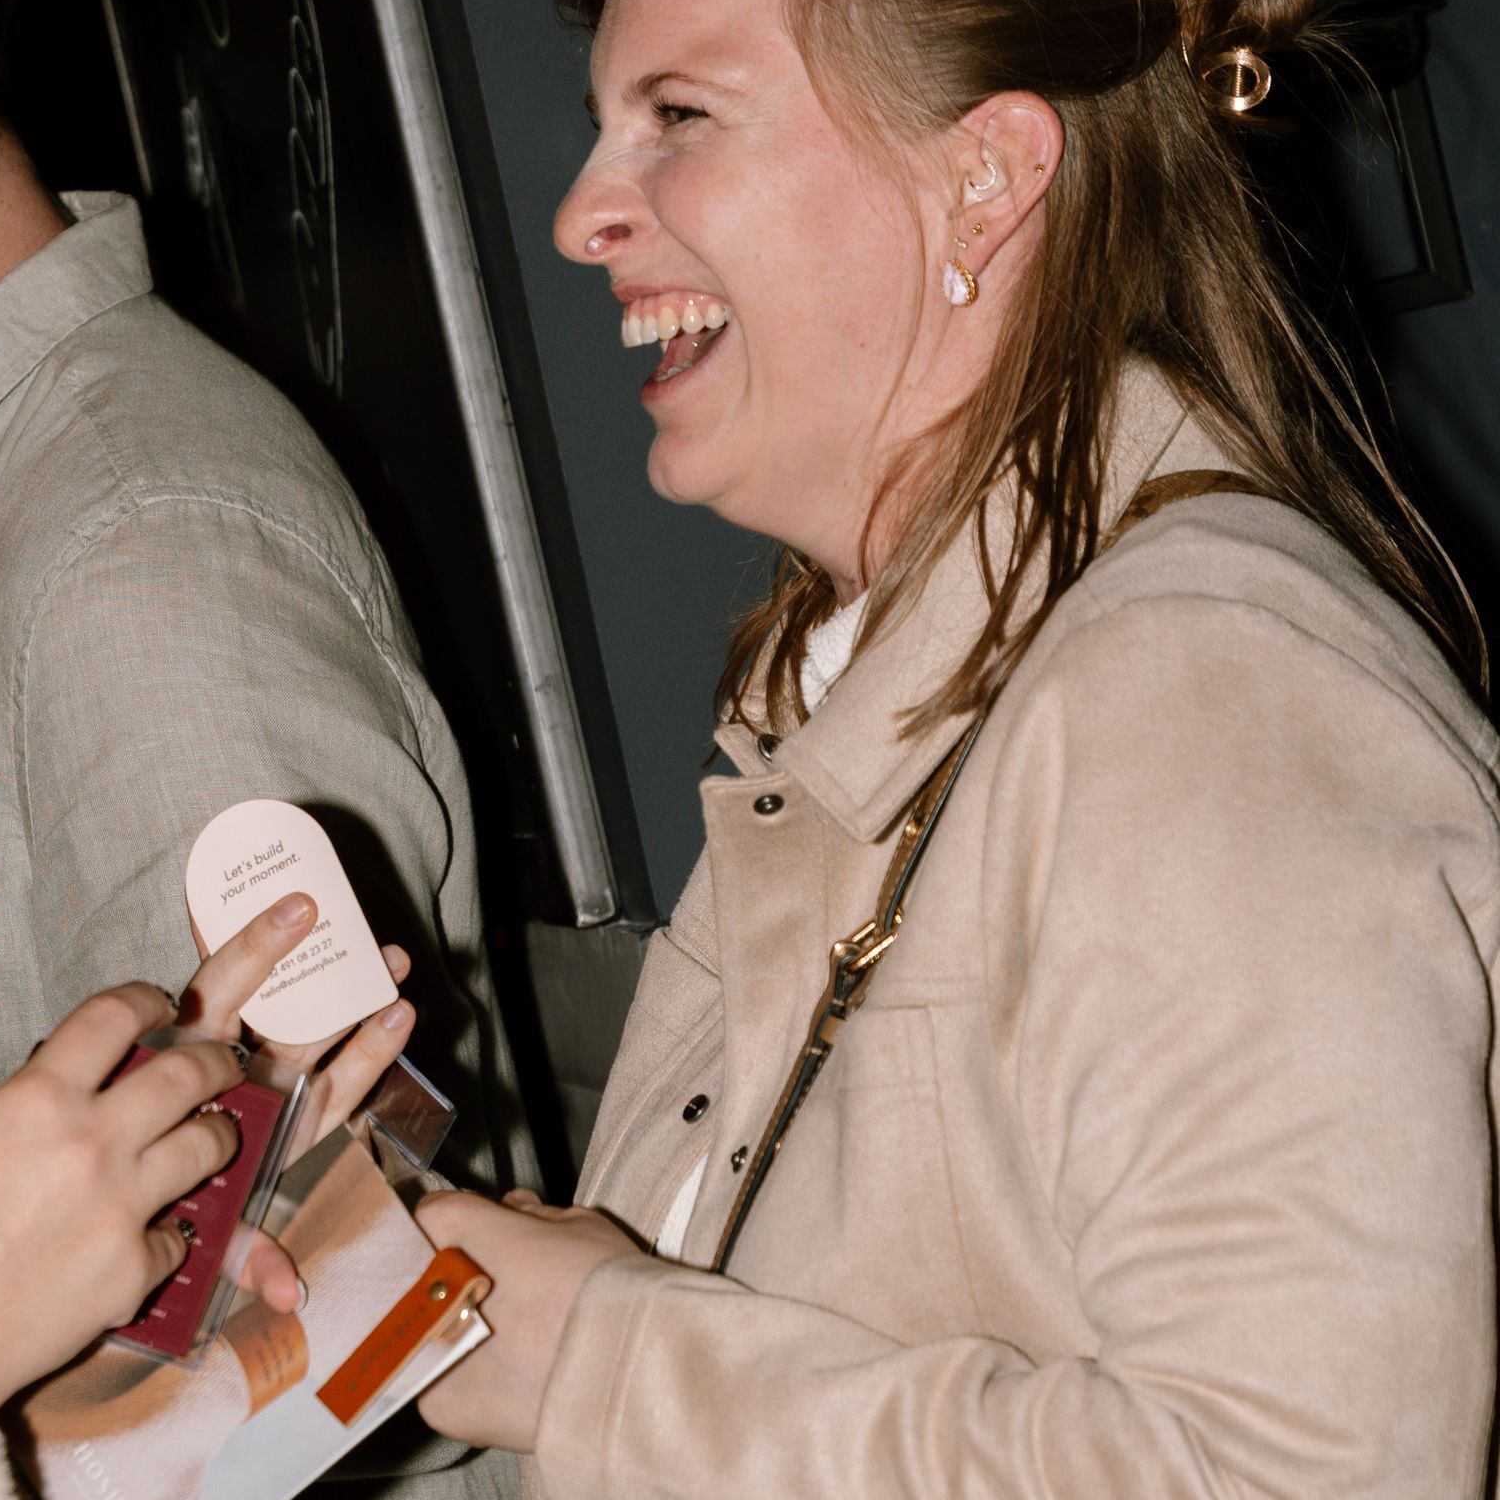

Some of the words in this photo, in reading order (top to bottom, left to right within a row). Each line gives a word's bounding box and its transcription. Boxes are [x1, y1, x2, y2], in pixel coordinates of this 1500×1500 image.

[221, 881, 246, 906] your
[249, 853, 301, 886] moment.
[224, 861, 252, 882] Let's
[254, 840, 284, 865] build
[280, 959, 296, 972] 491
[309, 944, 322, 957] 23
[321, 937, 332, 950] 27
